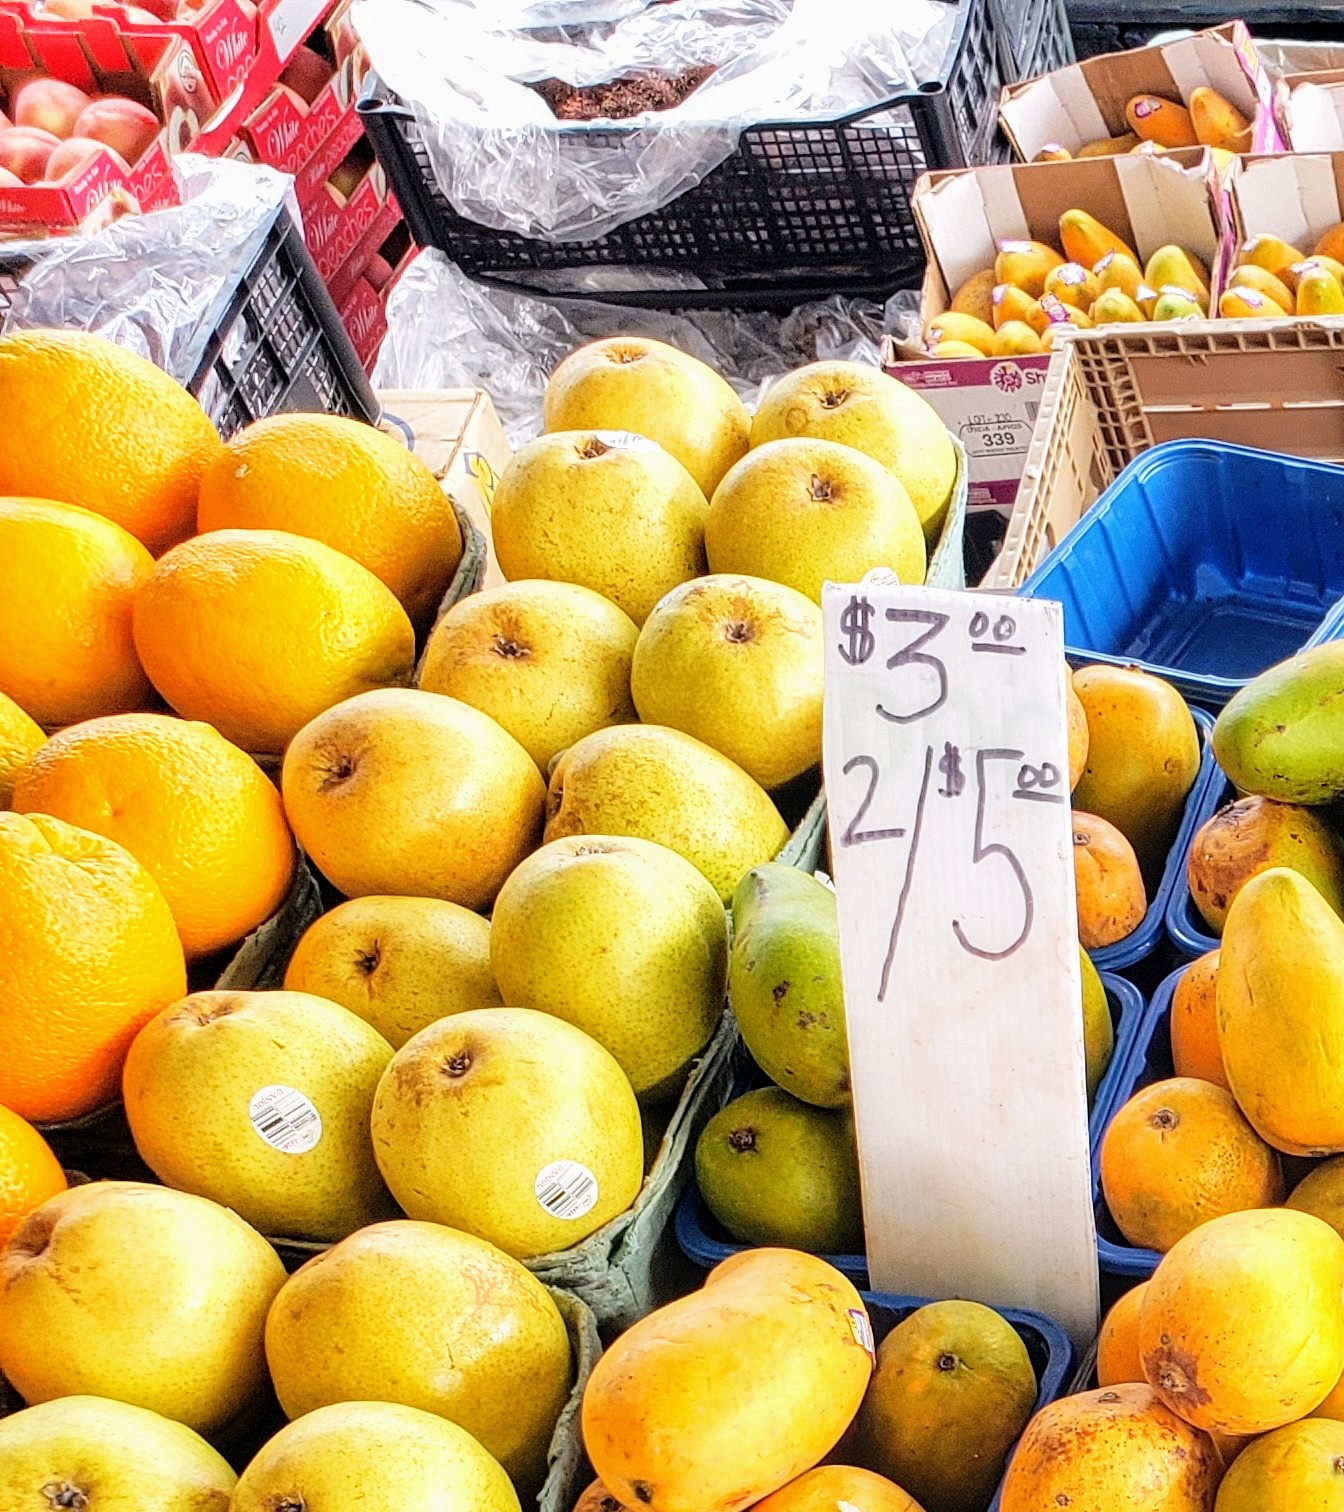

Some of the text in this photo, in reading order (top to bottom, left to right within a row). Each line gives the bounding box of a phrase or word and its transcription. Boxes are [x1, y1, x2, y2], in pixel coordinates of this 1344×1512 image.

[216, 16, 248, 69] White
[267, 106, 299, 160] White
[307, 201, 339, 250] White
[351, 293, 378, 344] White
[982, 432, 1015, 446] 339
